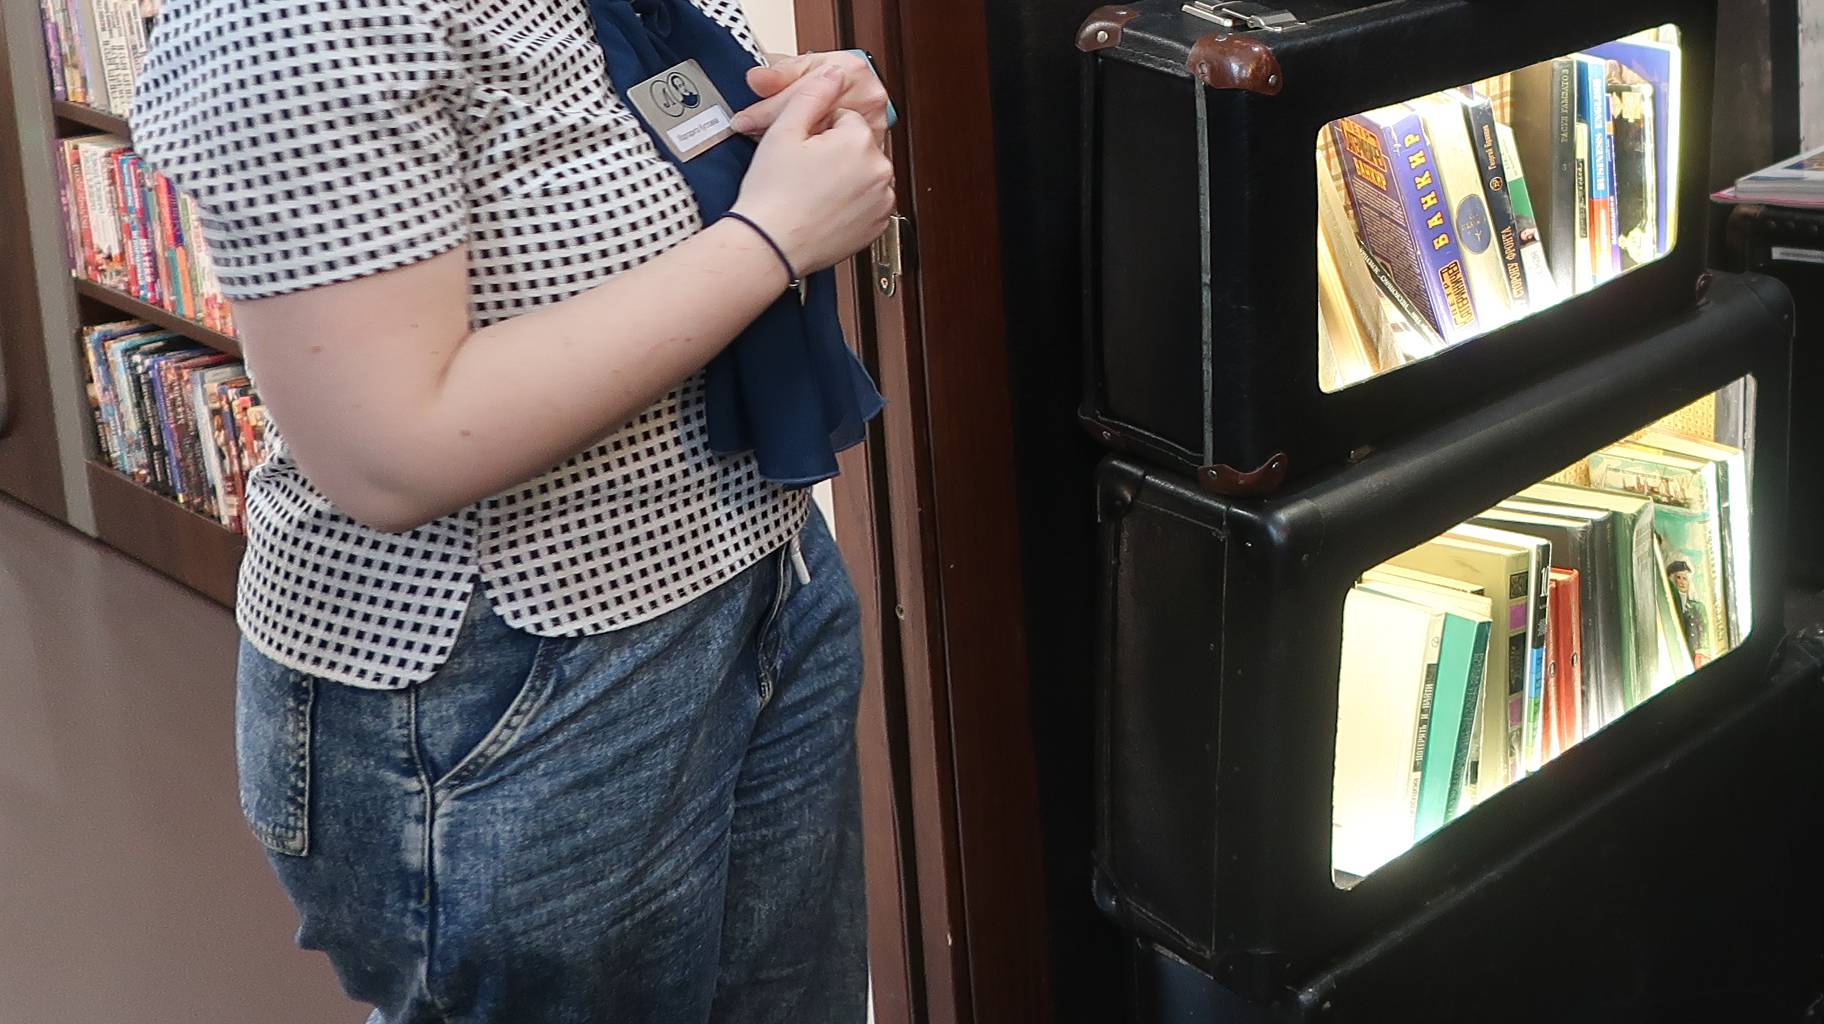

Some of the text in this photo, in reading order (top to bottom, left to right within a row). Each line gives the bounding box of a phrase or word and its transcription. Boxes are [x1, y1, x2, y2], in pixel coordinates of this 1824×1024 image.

[1560, 67, 1570, 114] ГАМЗАТОВ
[1592, 78, 1606, 191] BUSINESS ENGLISH
[1404, 133, 1451, 251] БАНКИР
[1501, 226, 1525, 299] СТОРОНУ ФРОНТА
[1421, 683, 1434, 709] НАЙТИ
[1415, 724, 1428, 762] ПОТЕРЯТЬ
